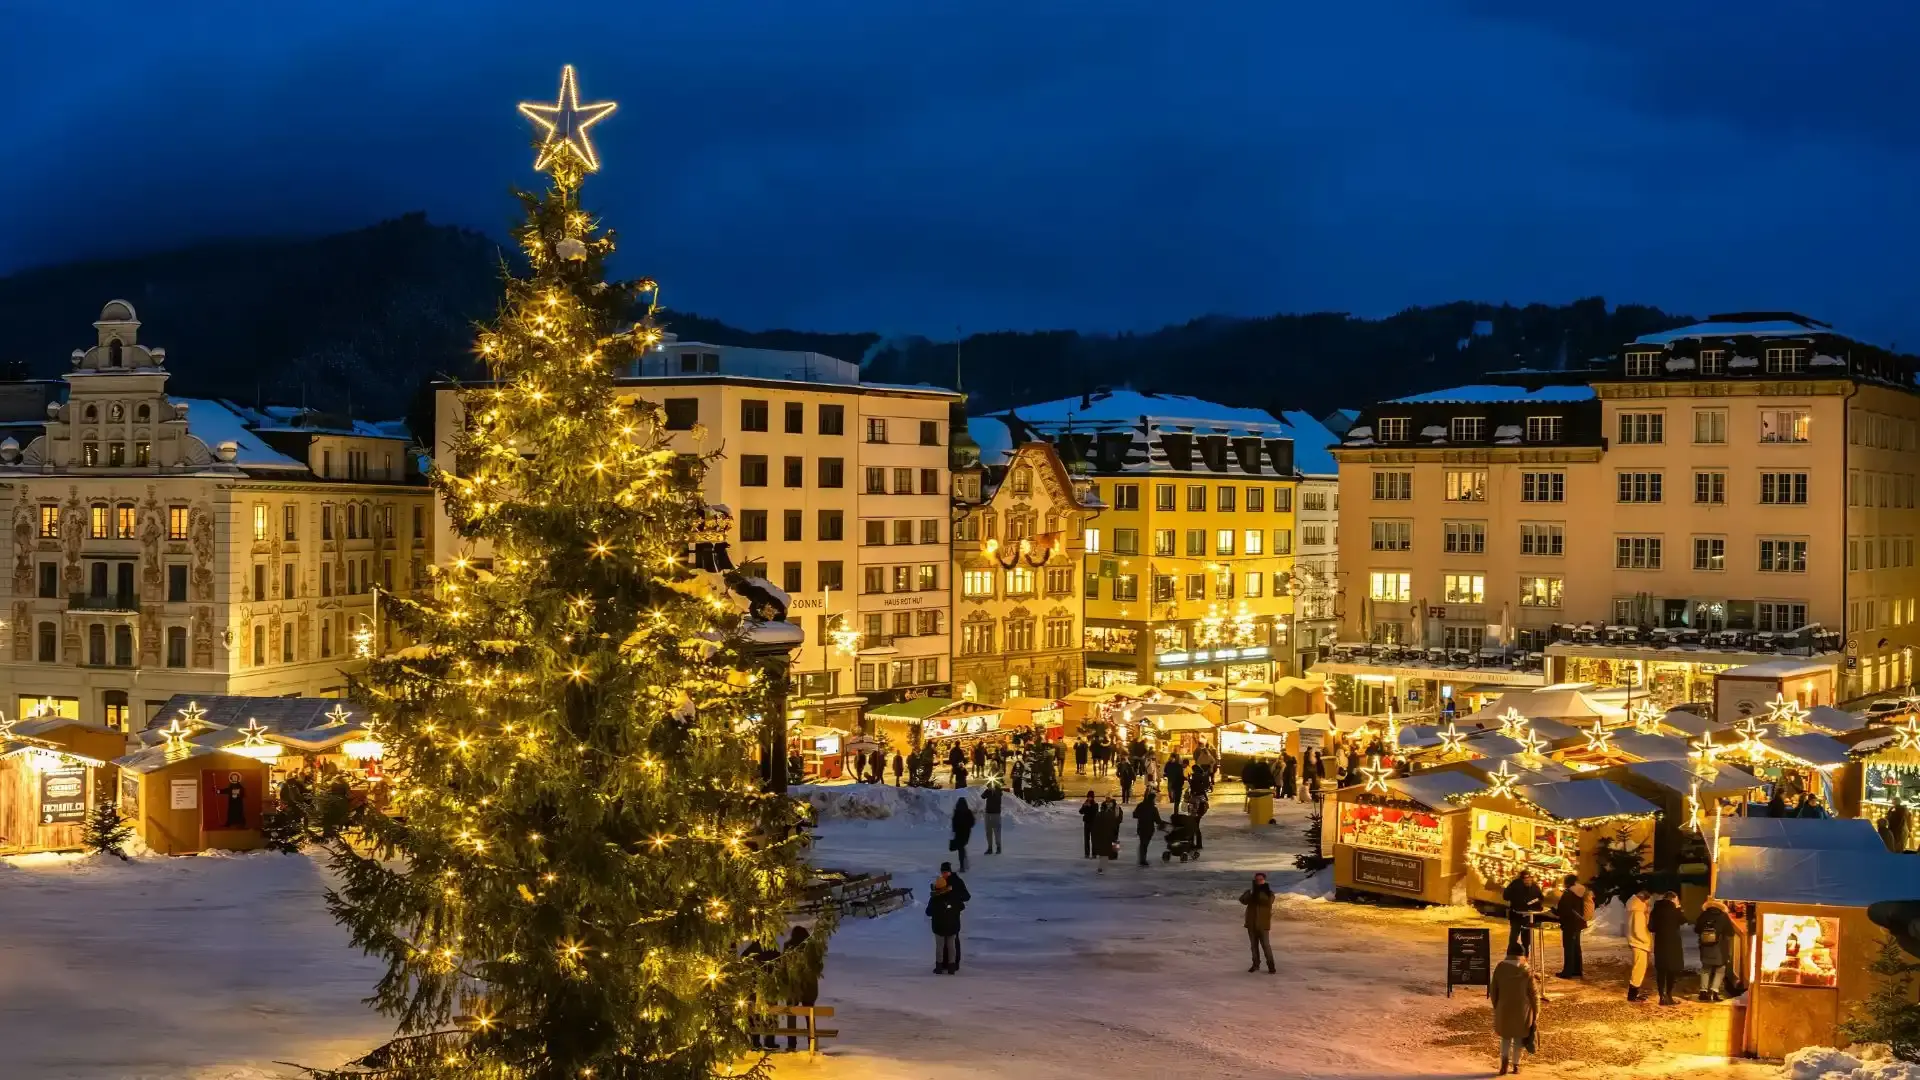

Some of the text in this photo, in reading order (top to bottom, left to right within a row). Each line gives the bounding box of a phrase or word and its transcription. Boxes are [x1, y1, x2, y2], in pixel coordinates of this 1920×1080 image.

[793, 599, 823, 609] SONNE
[912, 597, 923, 605] HUT
[1410, 605, 1446, 618] CFE
